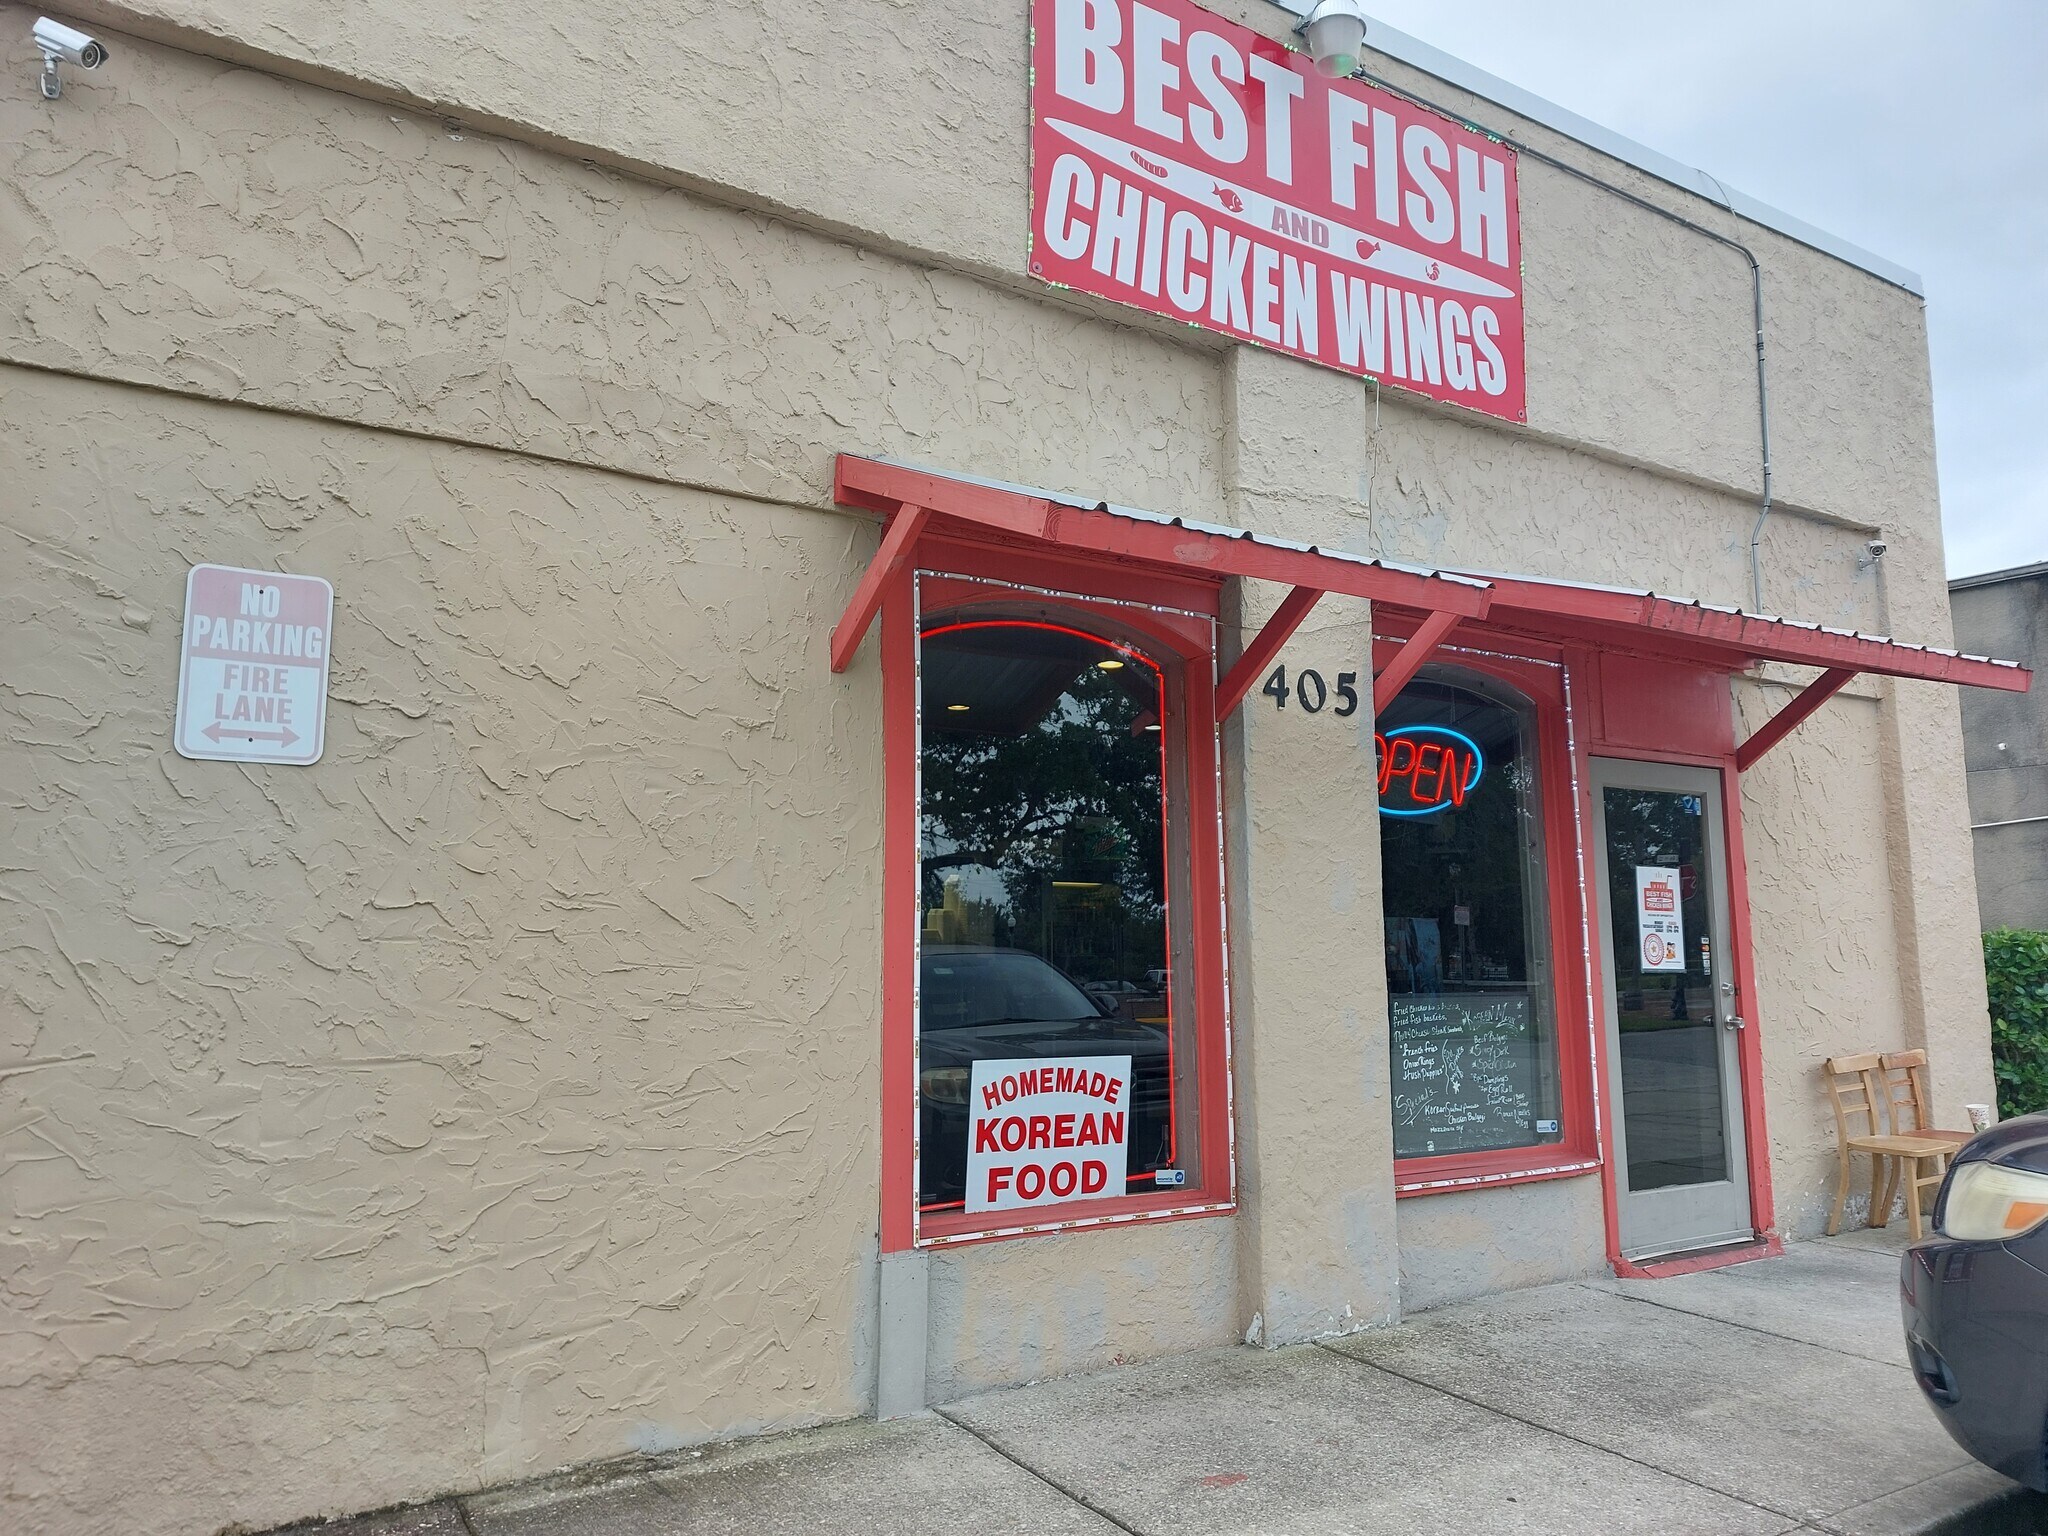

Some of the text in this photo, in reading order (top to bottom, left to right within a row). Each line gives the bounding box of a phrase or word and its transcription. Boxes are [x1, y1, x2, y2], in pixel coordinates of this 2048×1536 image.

[1055, 0, 1510, 269] BEST FISH
[1271, 205, 1330, 249] AND
[1044, 153, 1507, 396] CHICKEN WINGS
[240, 583, 280, 618] NO
[191, 614, 323, 659] PARKING
[223, 664, 289, 694] FIRE
[1262, 664, 1358, 717] 405
[214, 693, 293, 725] LANE
[982, 1067, 1123, 1111] HOMEMADE
[975, 1111, 1124, 1154] KOREAN
[987, 1160, 1108, 1203] FOOD
